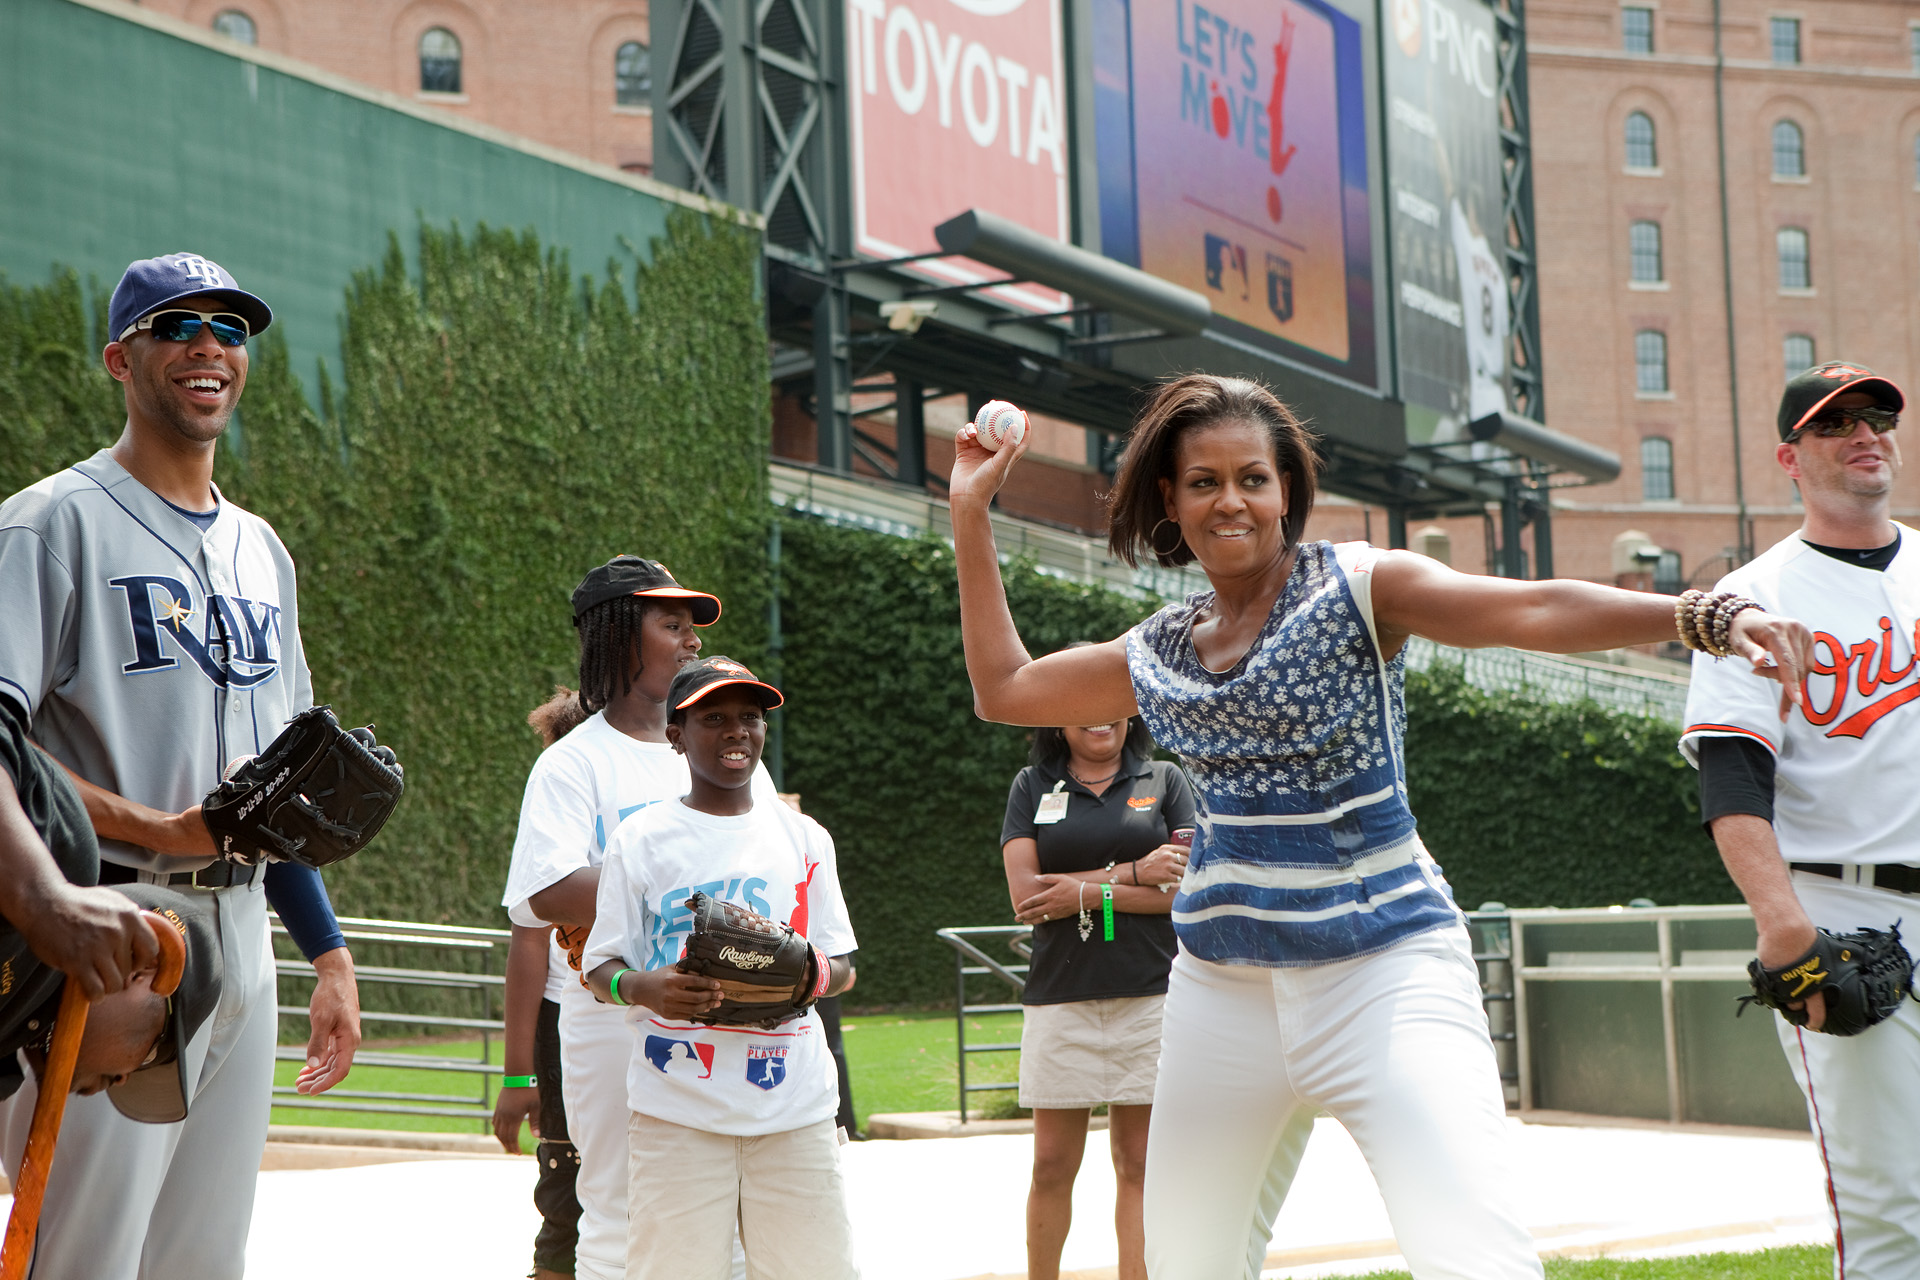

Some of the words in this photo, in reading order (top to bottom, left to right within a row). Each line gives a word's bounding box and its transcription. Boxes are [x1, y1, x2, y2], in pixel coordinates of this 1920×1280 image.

[1176, 0, 1258, 92] LET'S
[1427, 0, 1494, 98] PNC
[847, 0, 1064, 177] TOYOTA
[174, 256, 224, 288] TB
[719, 945, 775, 969] Rawlings
[747, 1049, 788, 1059] PLAYER
